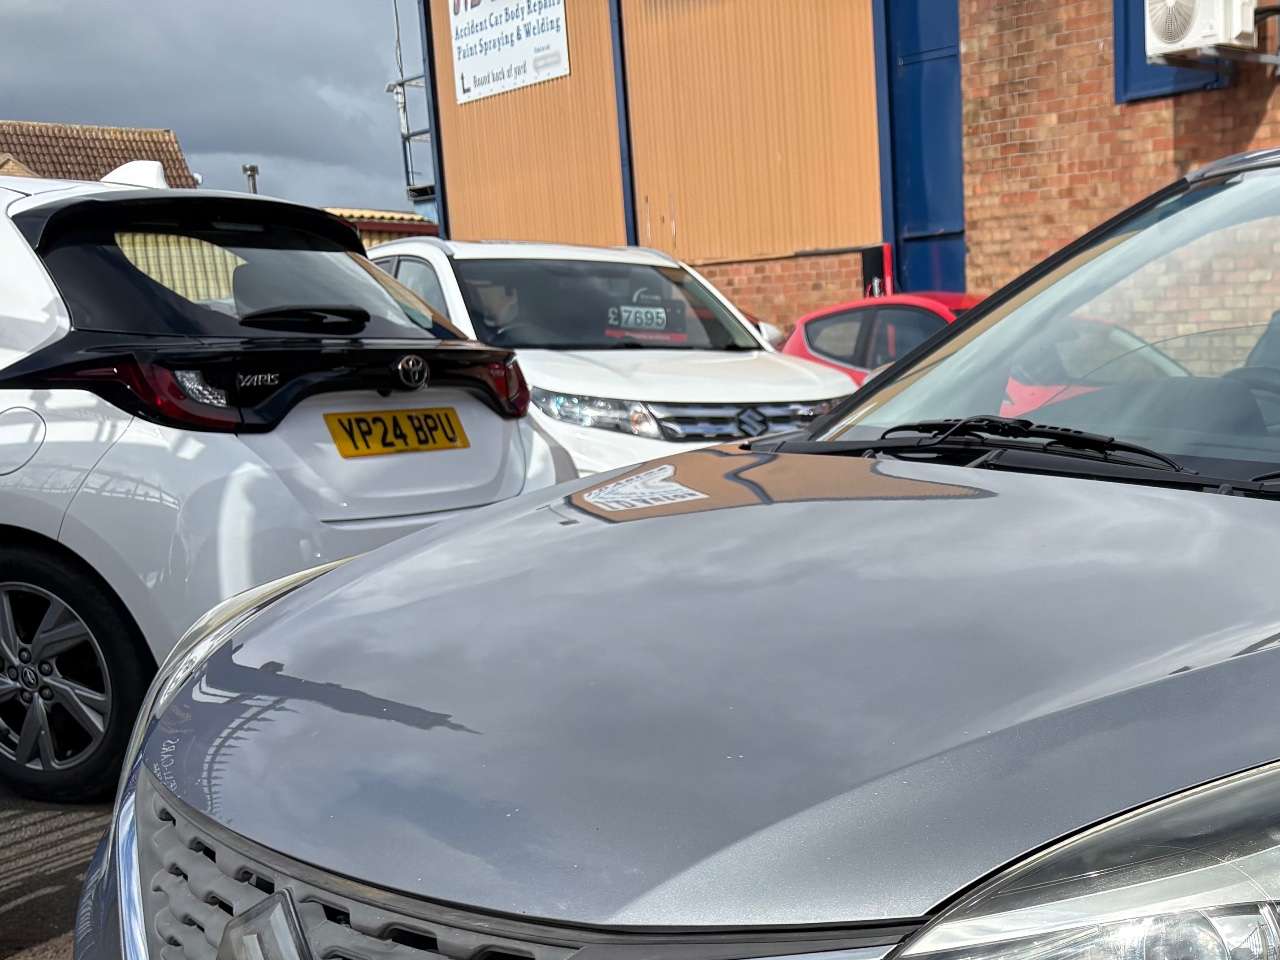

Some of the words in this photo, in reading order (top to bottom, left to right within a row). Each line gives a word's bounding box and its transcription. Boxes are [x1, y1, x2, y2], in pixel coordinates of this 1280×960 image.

[454, 18, 488, 41] Accident
[489, 12, 503, 28] Car
[505, 4, 526, 24] Body
[457, 41, 479, 62] Paint
[479, 31, 515, 57] Spraying
[516, 26, 523, 41] &
[523, 16, 561, 39] Welding
[239, 373, 280, 387] YARIS
[338, 415, 409, 450] YP24
[406, 412, 457, 446] BPU
